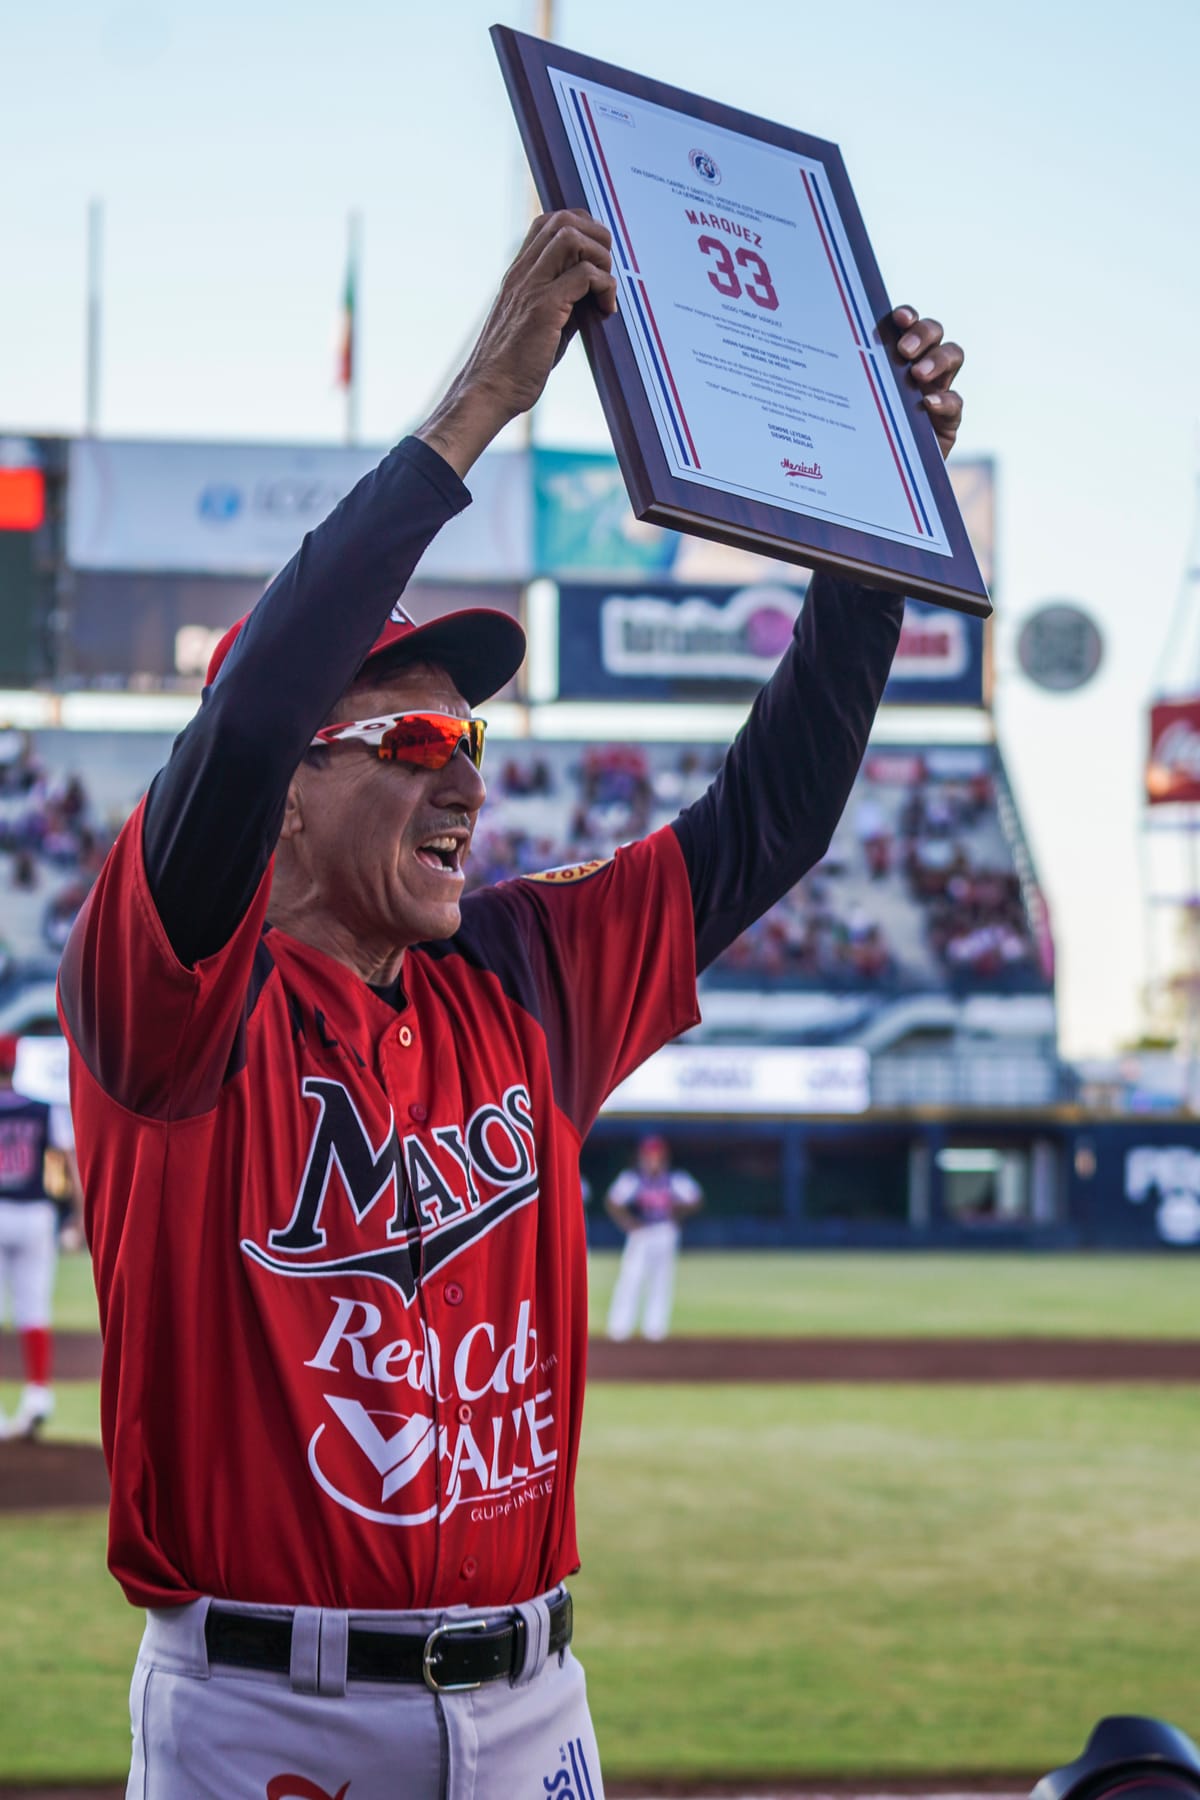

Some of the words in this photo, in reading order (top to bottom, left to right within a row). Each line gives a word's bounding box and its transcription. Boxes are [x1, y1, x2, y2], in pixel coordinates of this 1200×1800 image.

[685, 209, 763, 249] MARQUEZ
[697, 234, 780, 311] 33
[267, 1076, 538, 1254] MAYOS
